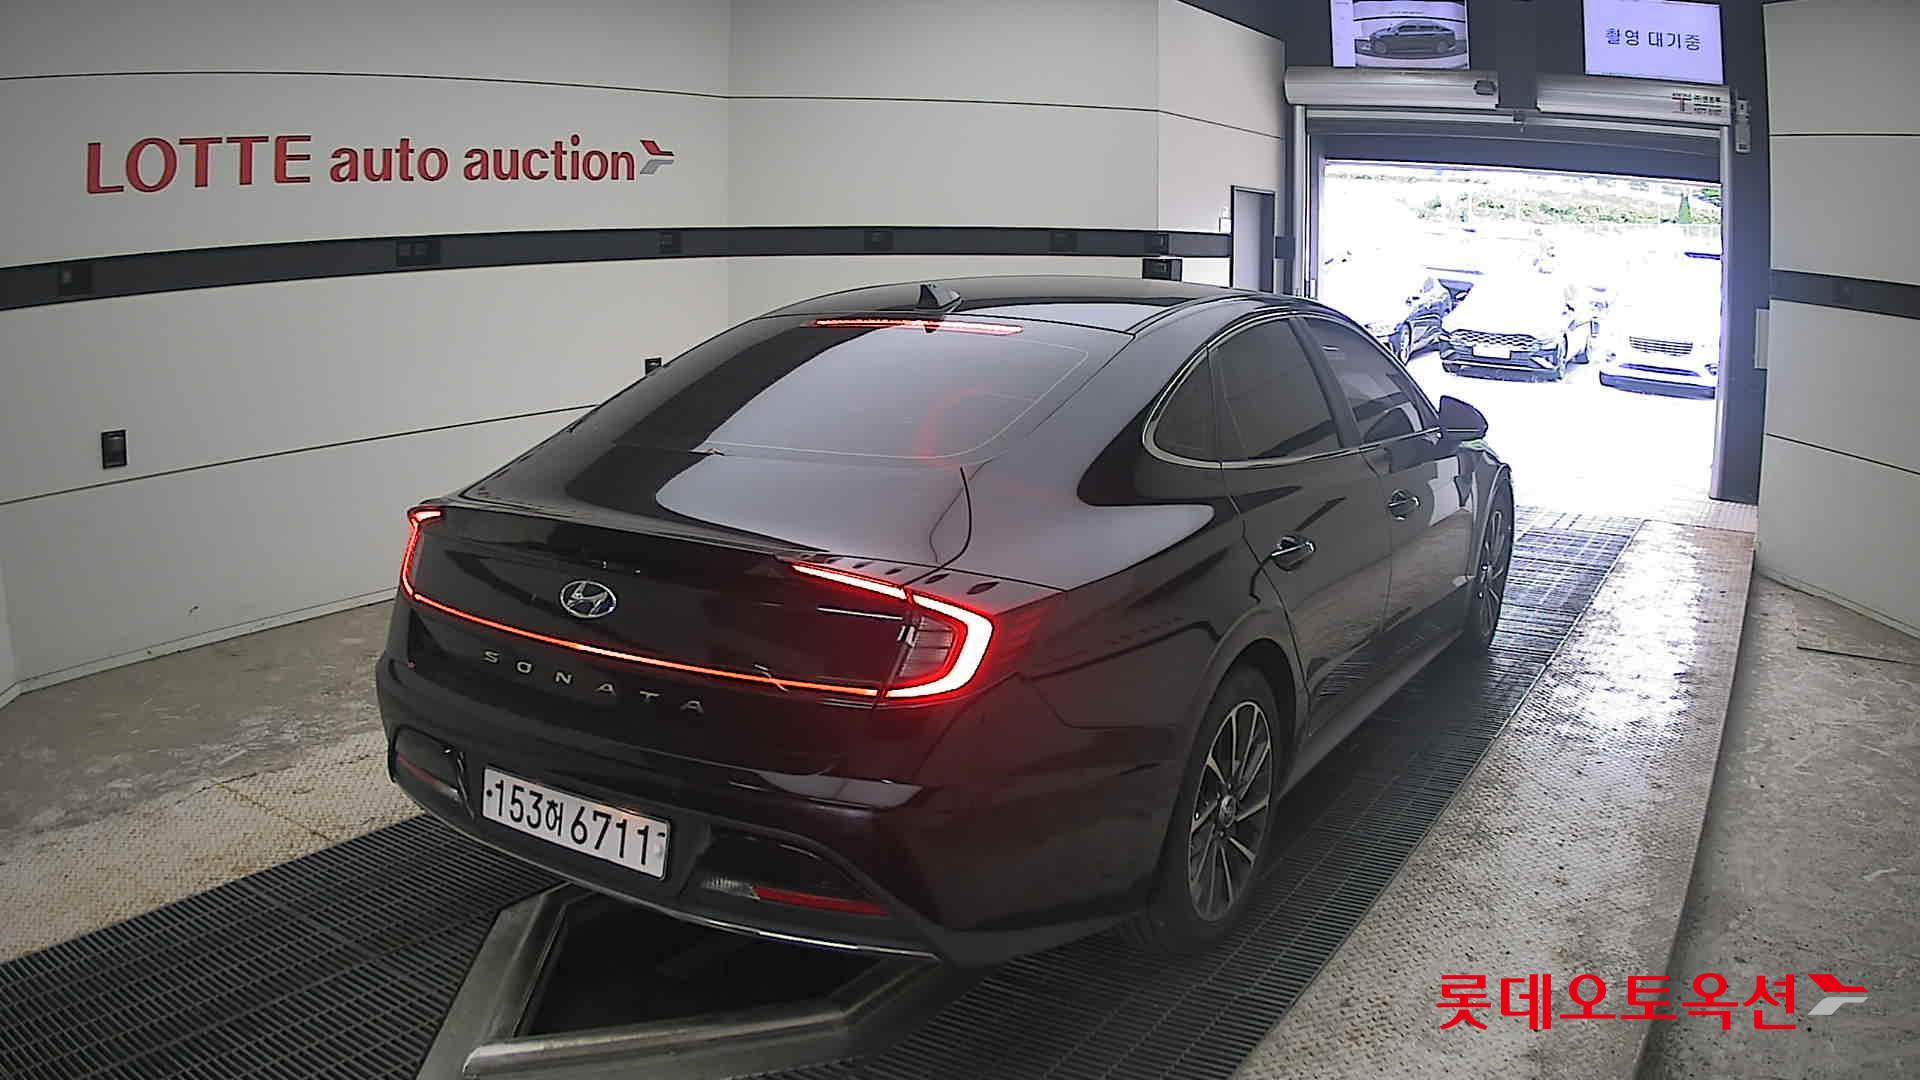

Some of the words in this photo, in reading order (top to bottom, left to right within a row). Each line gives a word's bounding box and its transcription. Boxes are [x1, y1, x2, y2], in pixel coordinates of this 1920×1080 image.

[1648, 31, 1701, 51] 대기중
[86, 135, 311, 194] LOTTE
[329, 138, 448, 183] auto
[463, 134, 636, 182] auction
[483, 650, 704, 714] SONATA
